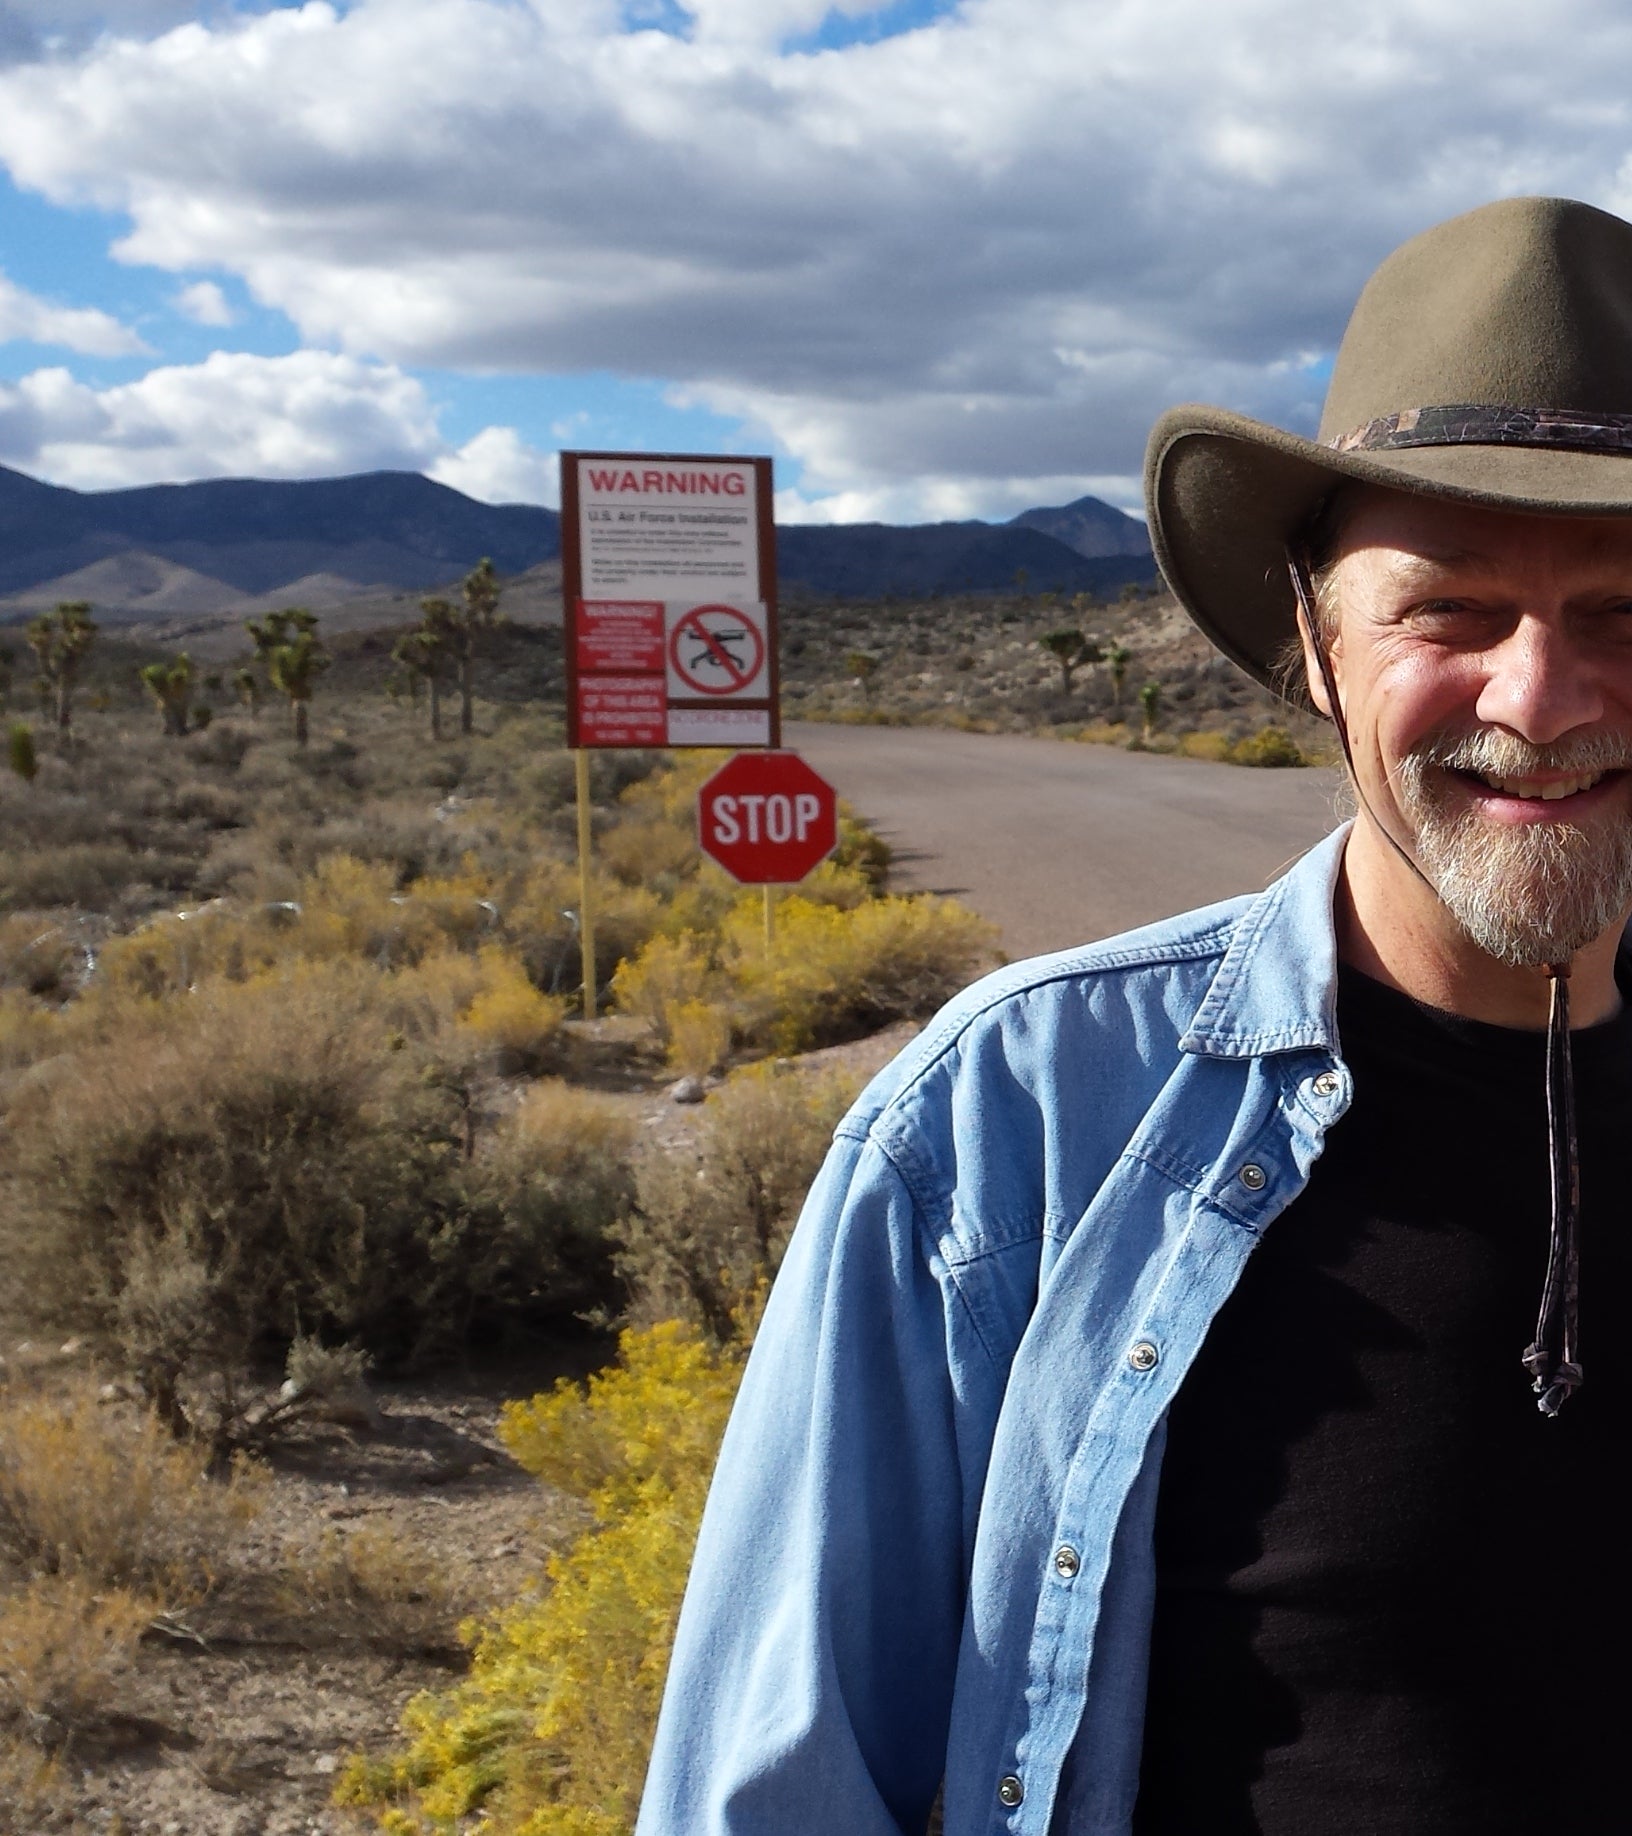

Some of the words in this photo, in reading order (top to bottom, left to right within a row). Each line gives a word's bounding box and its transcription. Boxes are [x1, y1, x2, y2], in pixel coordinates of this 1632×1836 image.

[588, 469, 745, 496] WARNING
[588, 510, 612, 522] U.S.
[618, 511, 635, 523] Air
[639, 510, 675, 523] Force
[678, 513, 748, 524] Installation
[712, 793, 820, 845] STOP
